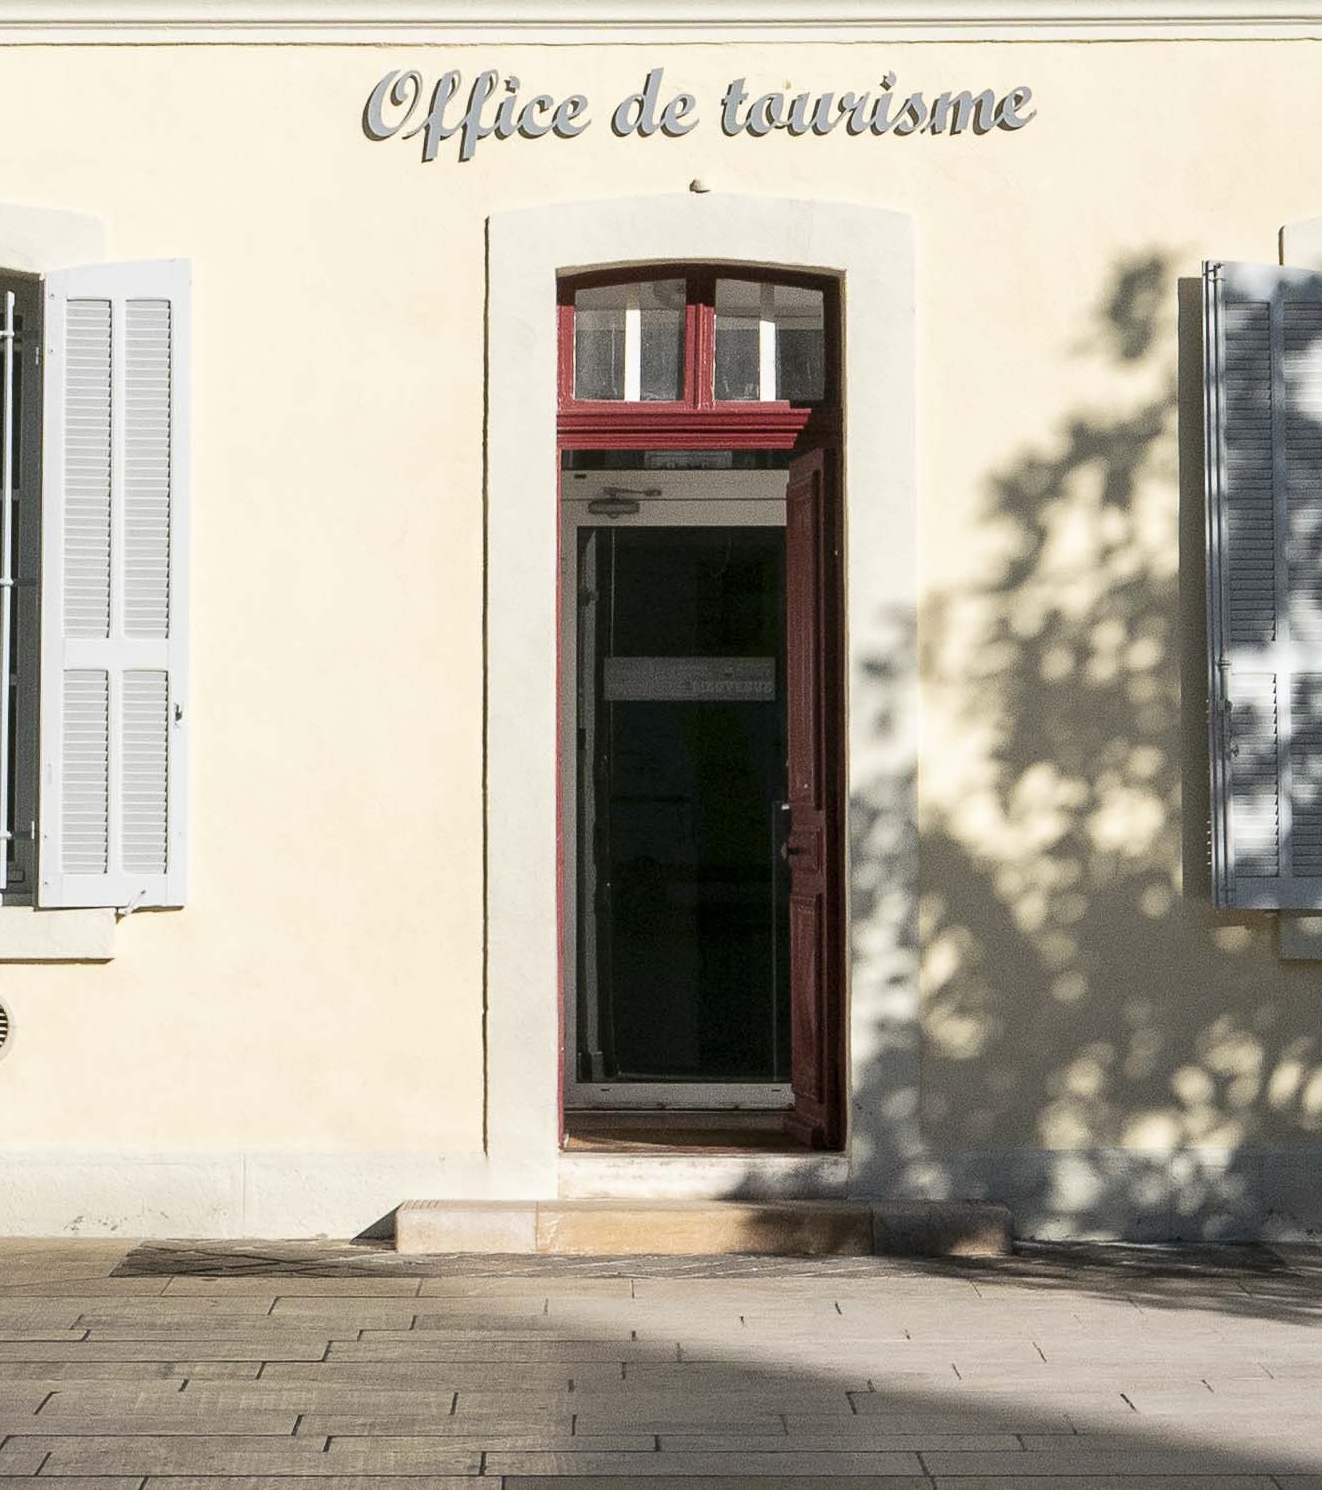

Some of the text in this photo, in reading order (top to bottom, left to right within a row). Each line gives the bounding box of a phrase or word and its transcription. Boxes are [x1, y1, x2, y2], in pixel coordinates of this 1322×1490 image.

[361, 67, 1037, 163] Office de tourisme
